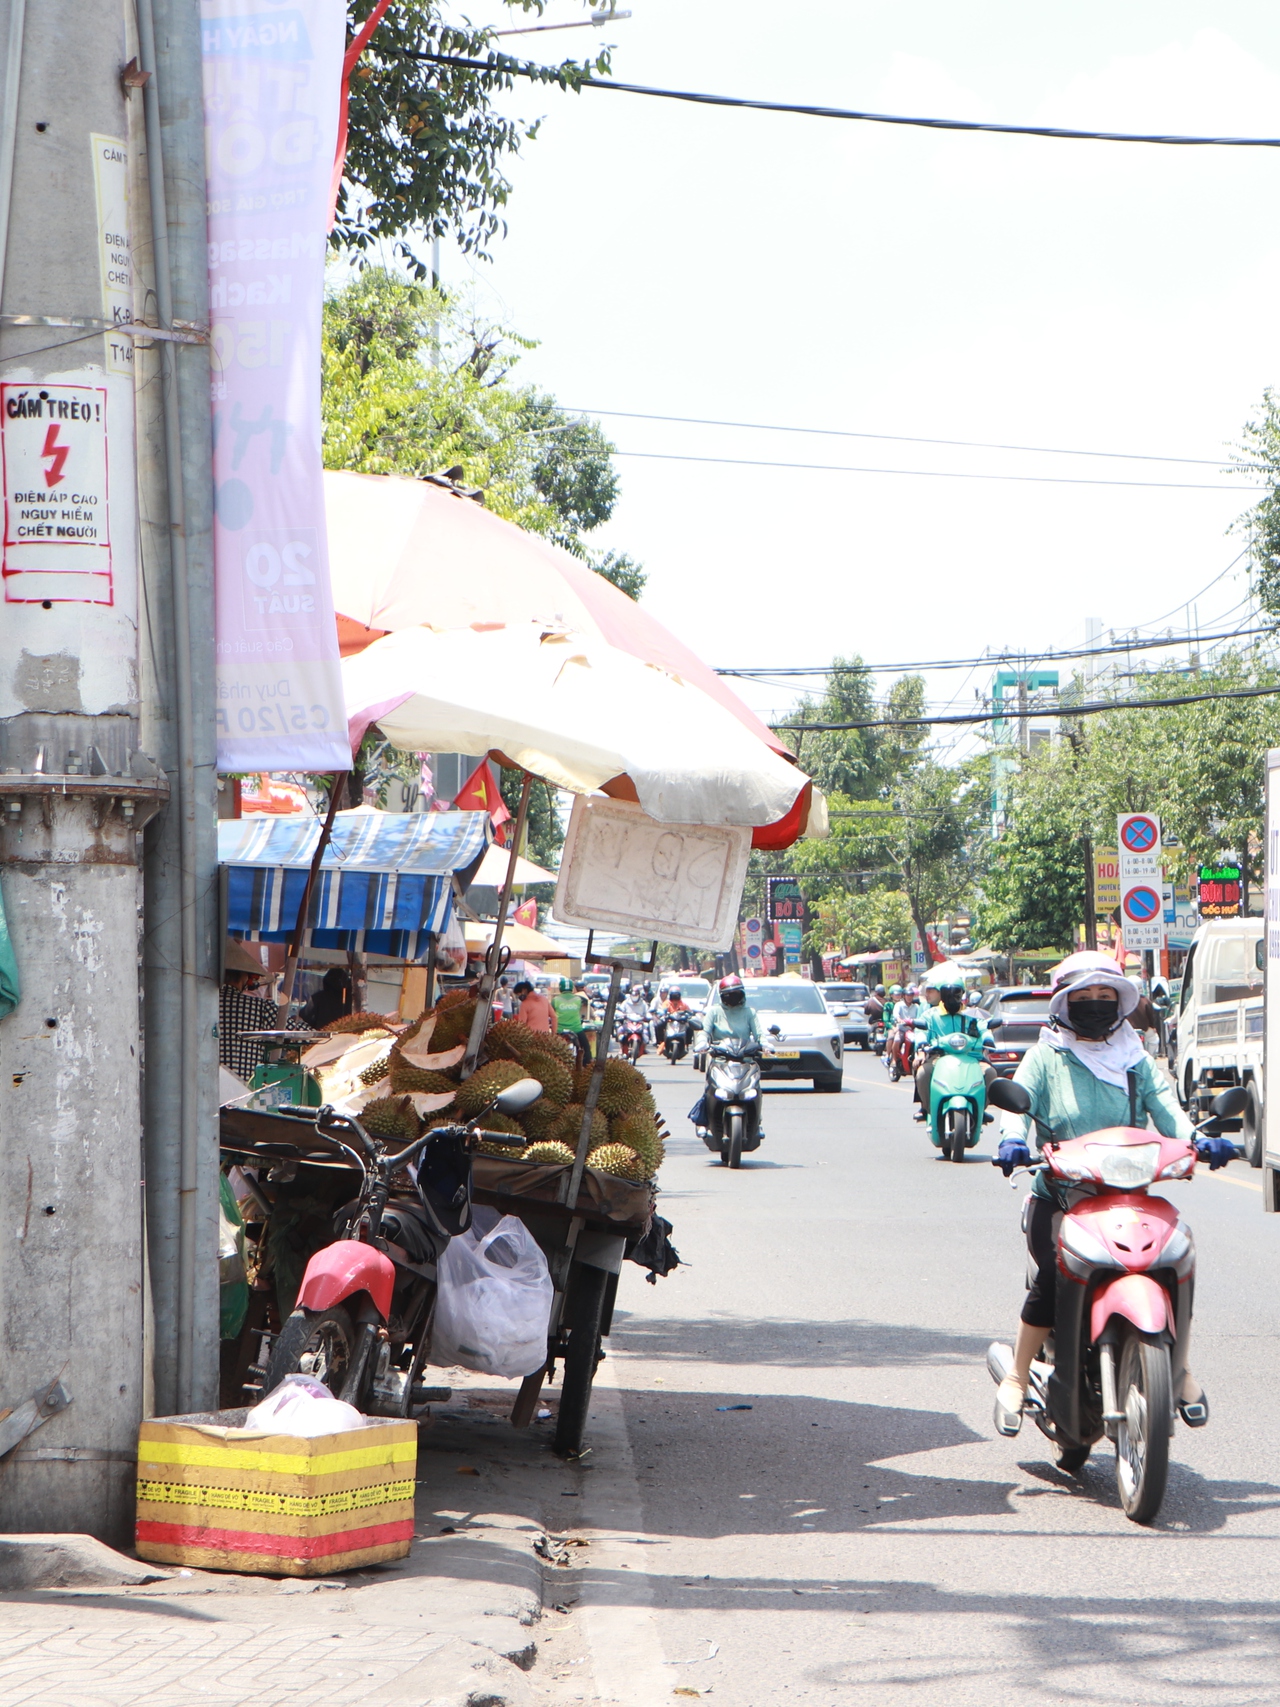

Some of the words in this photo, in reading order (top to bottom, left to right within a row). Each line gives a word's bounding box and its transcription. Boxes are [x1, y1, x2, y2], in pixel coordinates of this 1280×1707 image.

[7, 390, 42, 419] CẤM
[14, 491, 46, 504] ĐIỆN
[48, 490, 68, 504] ÁP
[71, 494, 98, 506] CAO
[21, 509, 58, 522] NGUY
[61, 505, 94, 521] HIỂM
[17, 521, 53, 538] CHẾT
[56, 523, 98, 539] NGƯỜI
[328, 1496, 348, 1504] FRAGILE
